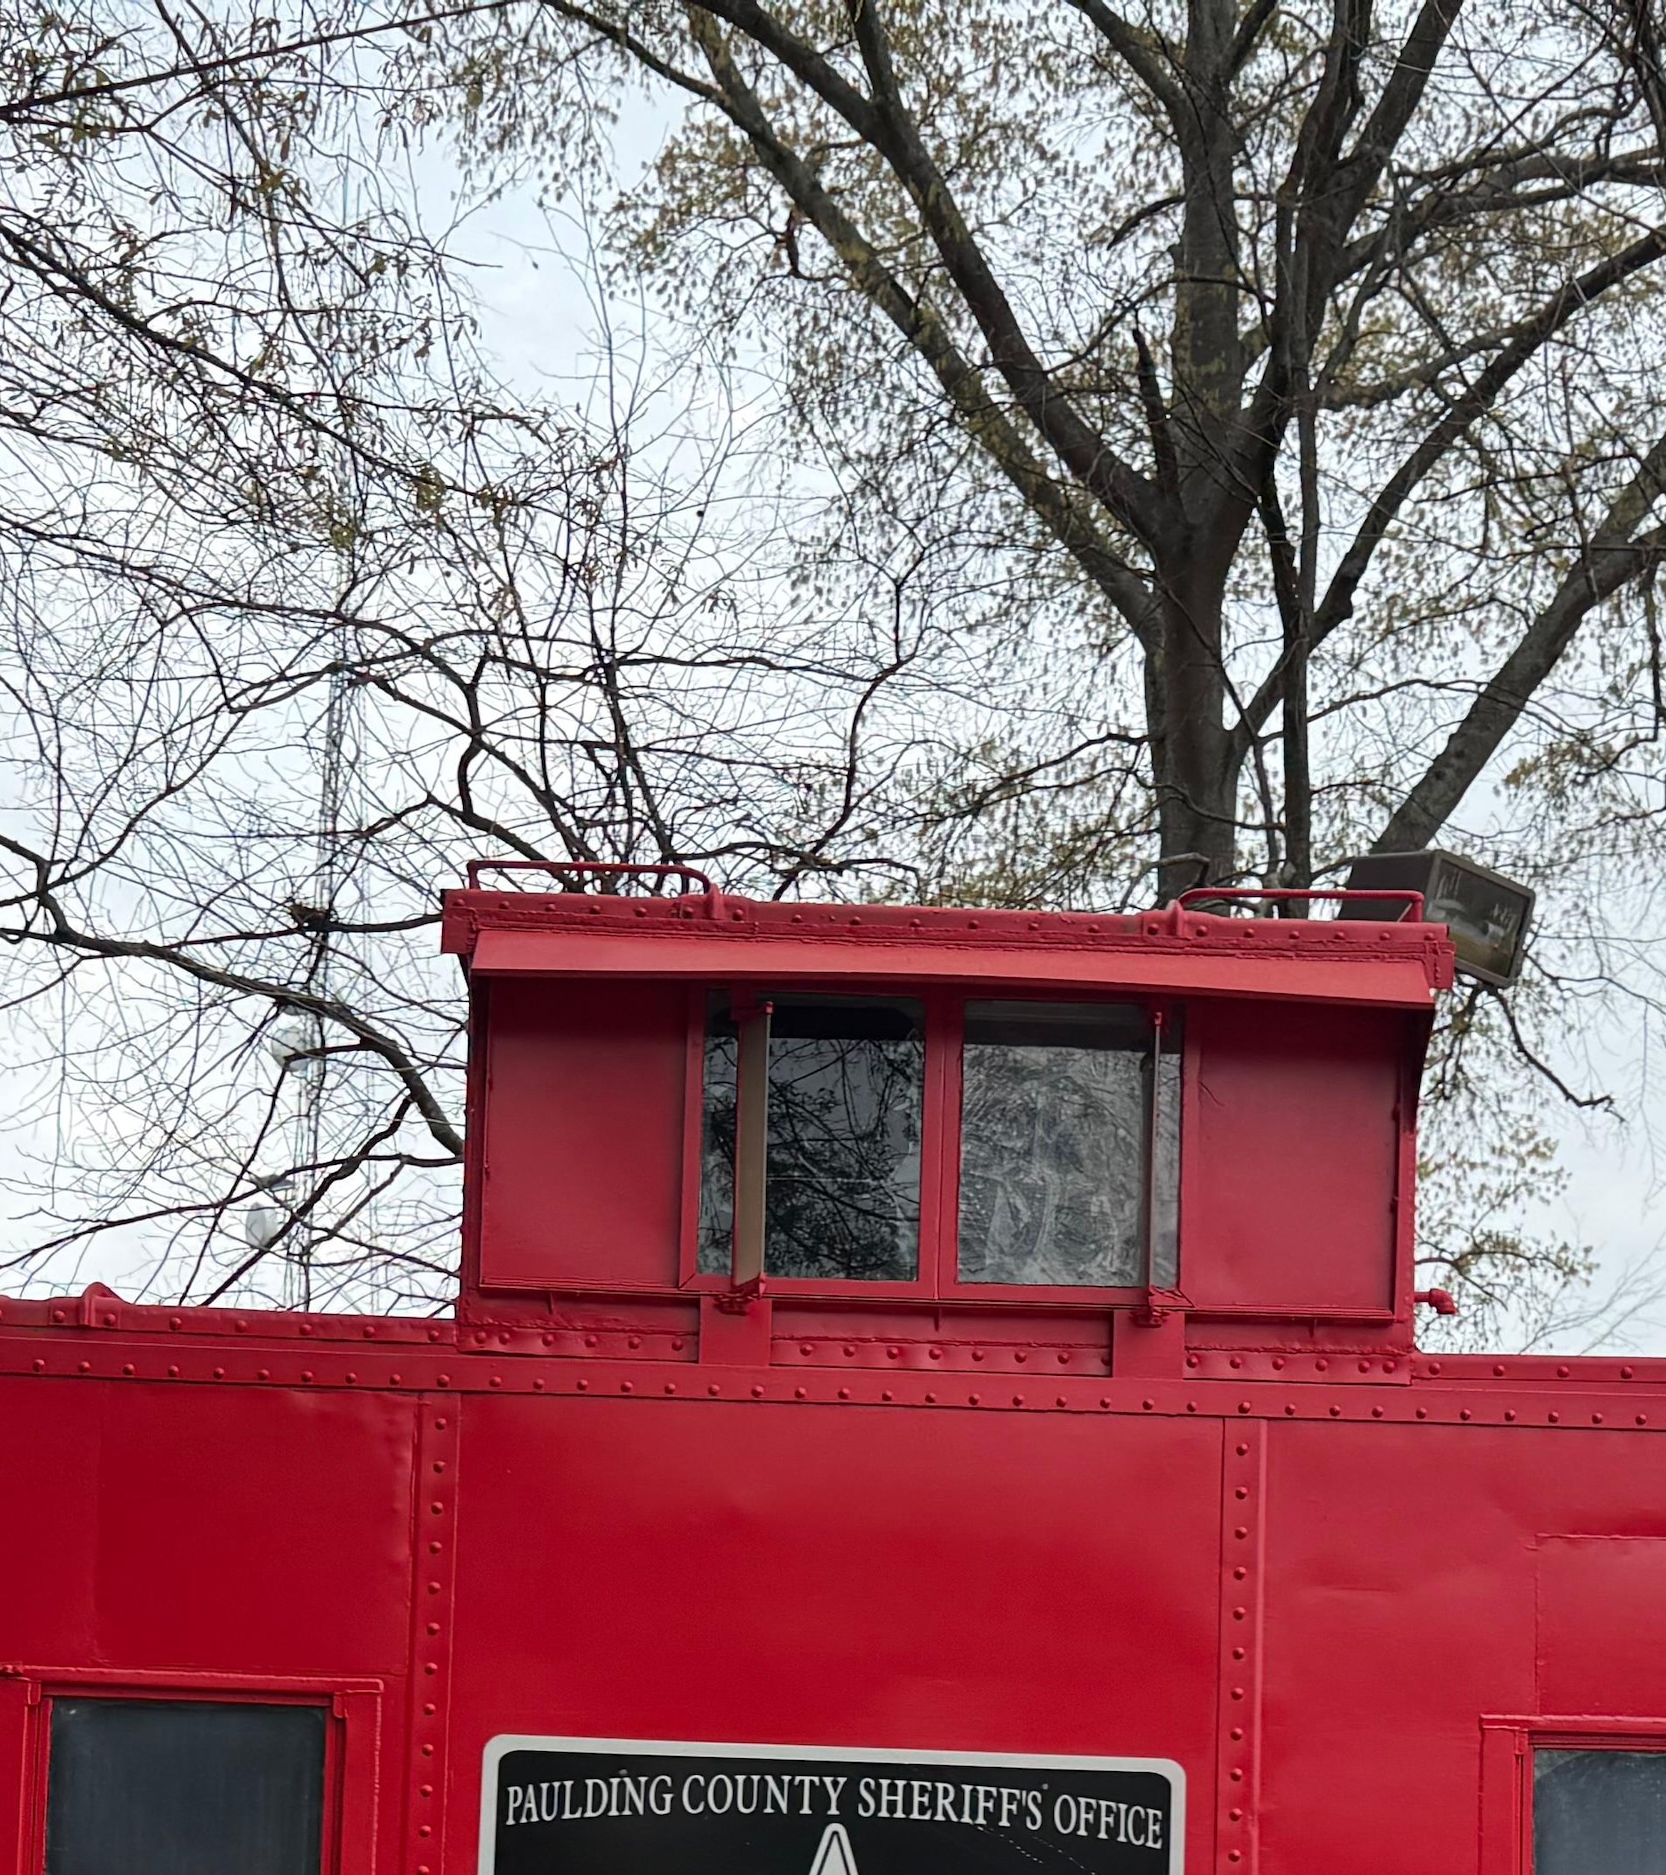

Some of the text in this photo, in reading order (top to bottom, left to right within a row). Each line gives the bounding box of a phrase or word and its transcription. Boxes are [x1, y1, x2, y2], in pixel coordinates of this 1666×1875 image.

[505, 1773, 1165, 1850] PAULDING COUNTY SHERIFF'S OFFICE
